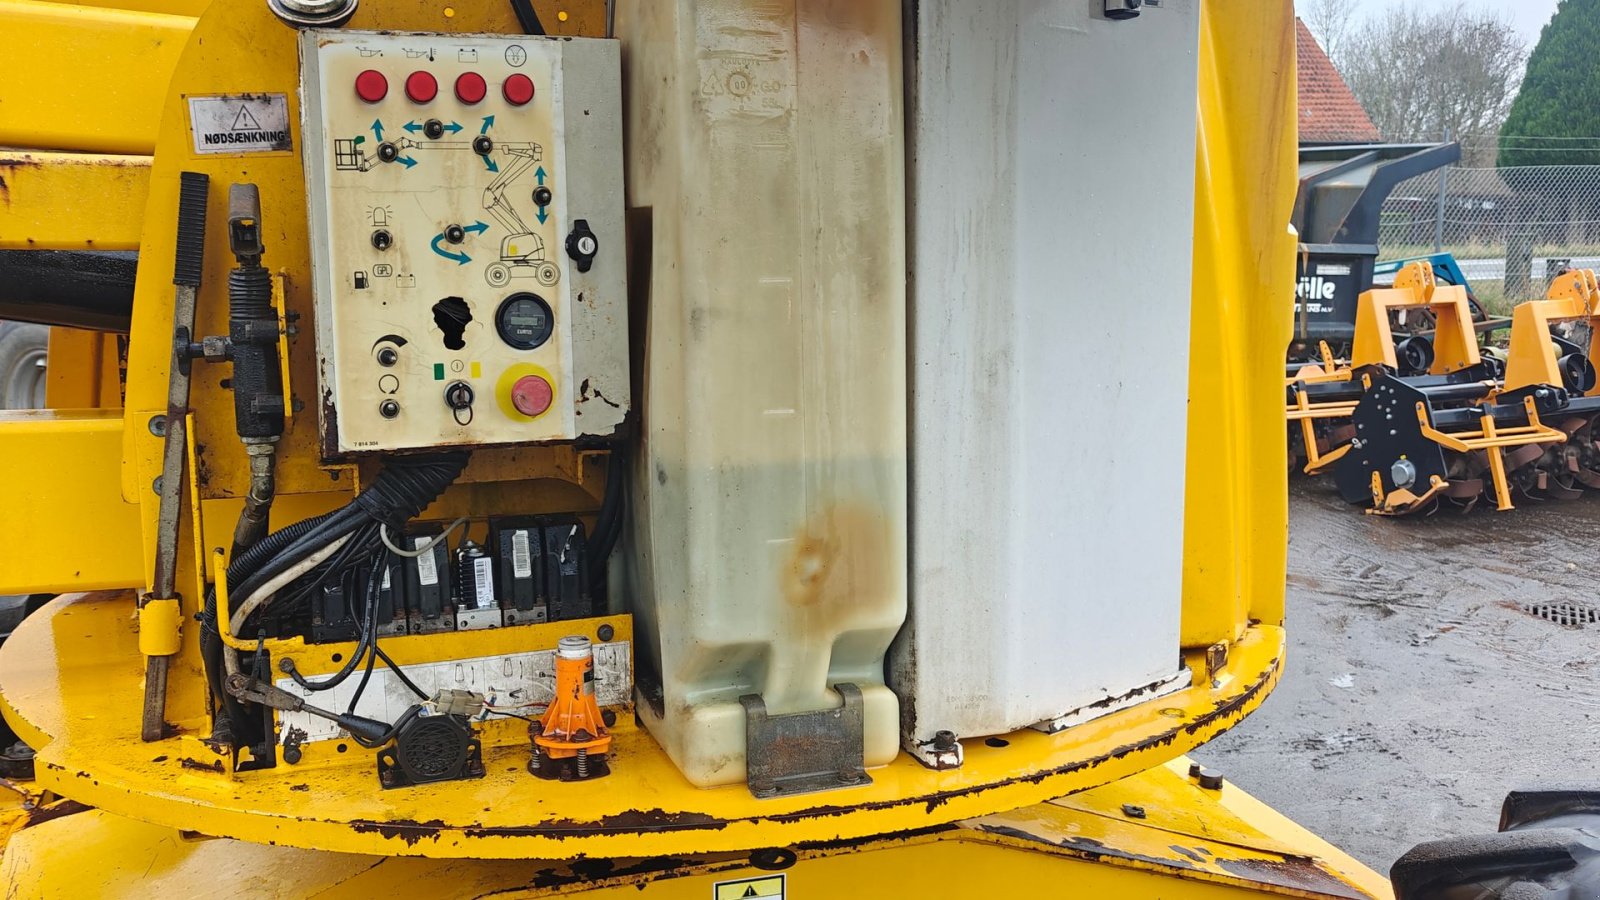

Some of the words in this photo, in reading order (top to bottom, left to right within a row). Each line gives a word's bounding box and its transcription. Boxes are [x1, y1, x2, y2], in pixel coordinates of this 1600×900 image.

[204, 130, 285, 145] NØDSÆNKNING
[377, 266, 390, 275] GPL
[1295, 276, 1336, 300] ëlle
